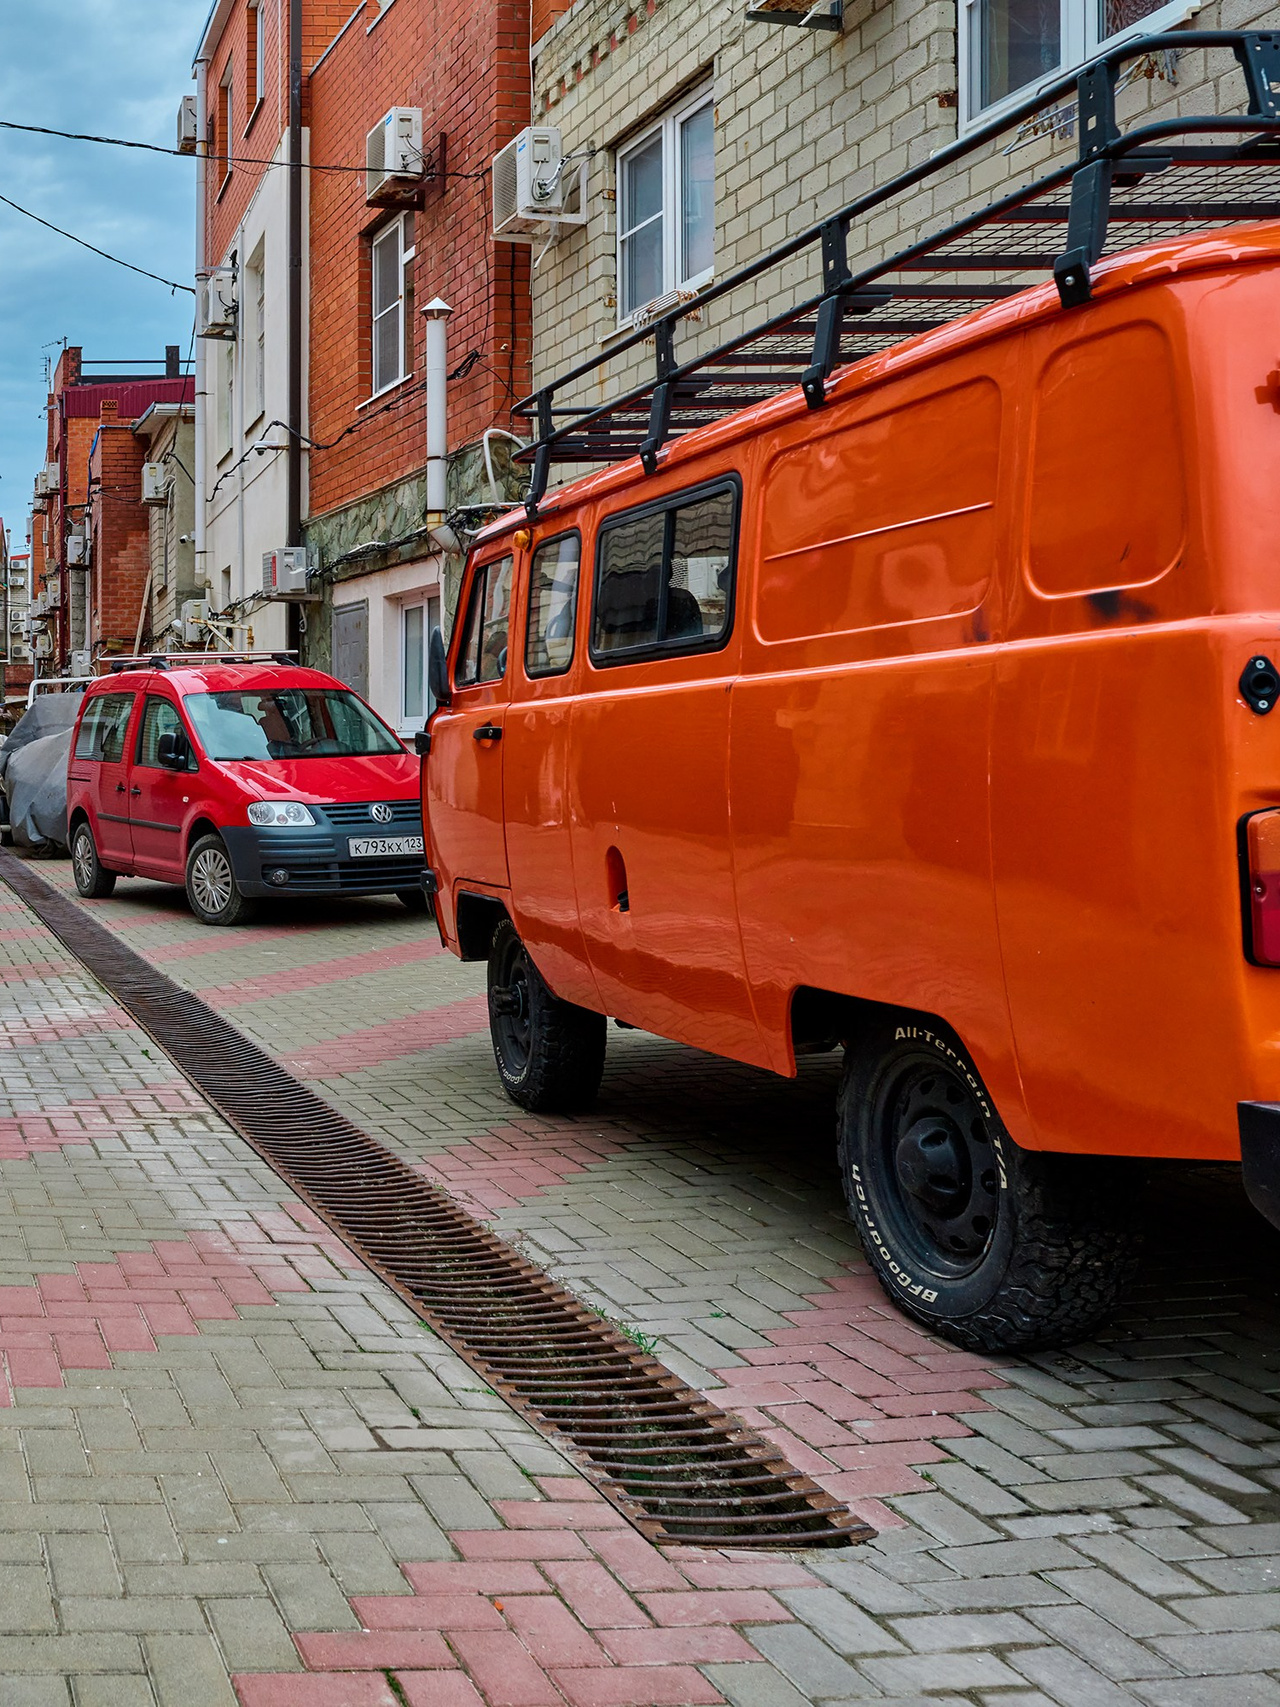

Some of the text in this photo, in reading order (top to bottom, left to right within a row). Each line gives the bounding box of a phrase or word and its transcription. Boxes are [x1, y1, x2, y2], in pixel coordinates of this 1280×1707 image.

[404, 838, 422, 849] 123
[894, 1026, 1008, 1189] All-Terrain T/A
[852, 1164, 939, 1303] BFGoodrich
